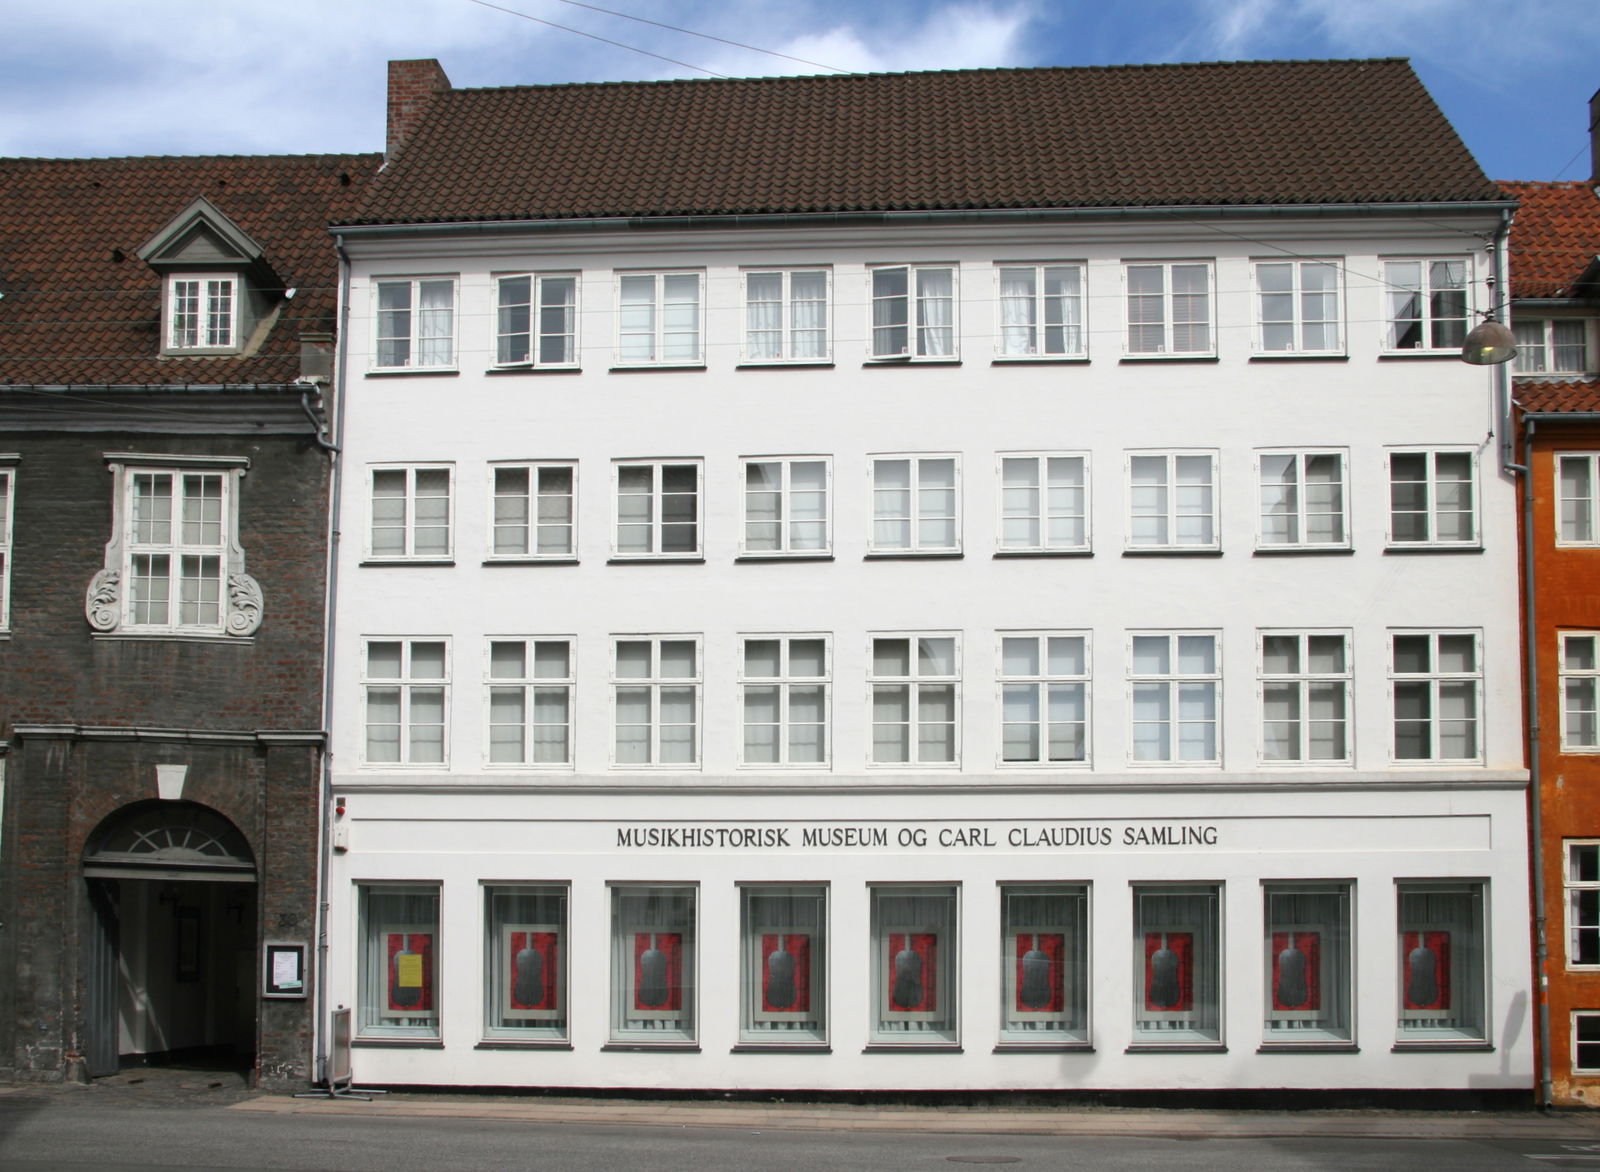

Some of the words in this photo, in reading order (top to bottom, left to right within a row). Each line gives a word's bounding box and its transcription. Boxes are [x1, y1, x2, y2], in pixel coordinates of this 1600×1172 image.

[617, 828, 790, 847] MUSIKHISTORISK
[802, 828, 888, 847] MUSEUM
[898, 828, 928, 847] OG
[938, 827, 997, 847] CARL
[1008, 827, 1112, 846] CLAUDIUS
[1123, 826, 1218, 846] SAMLING
